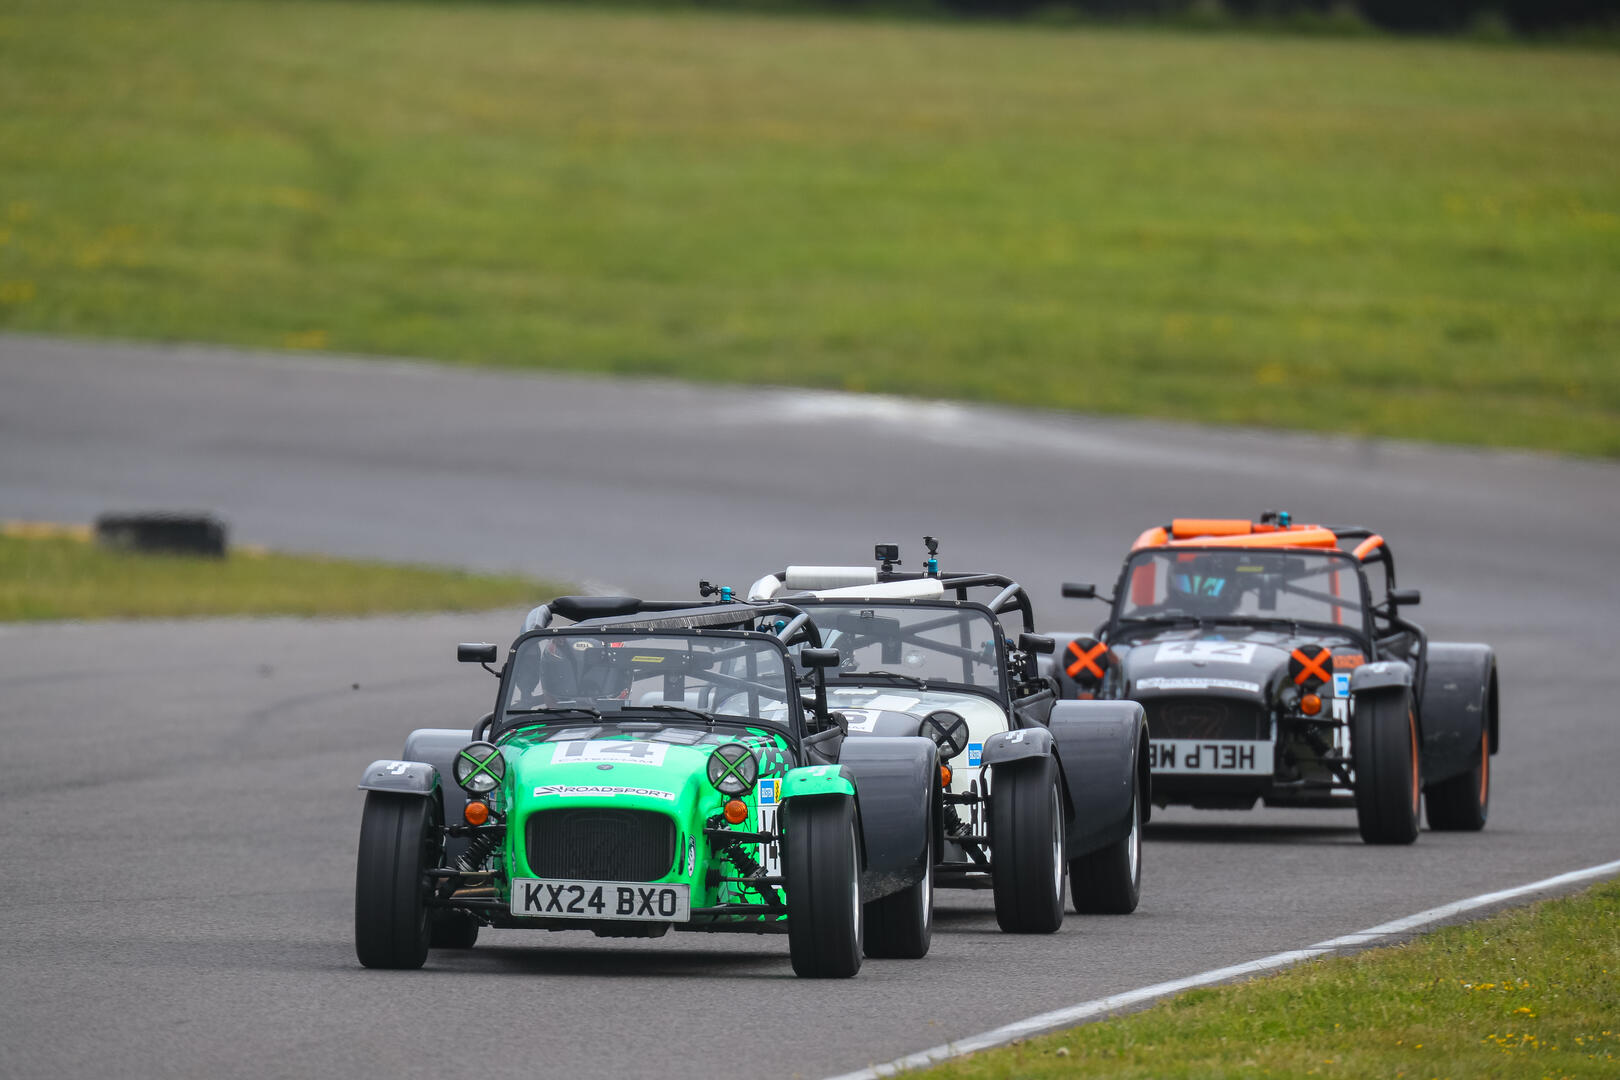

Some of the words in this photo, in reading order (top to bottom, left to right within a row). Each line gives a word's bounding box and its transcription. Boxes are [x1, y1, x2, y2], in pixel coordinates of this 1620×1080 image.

[1167, 642, 1247, 656] 42
[565, 741, 654, 758] 14
[1184, 744, 1255, 769] HELP
[563, 785, 673, 798] ROADSPORT
[524, 883, 606, 914] KX24
[616, 887, 677, 917] BXO
